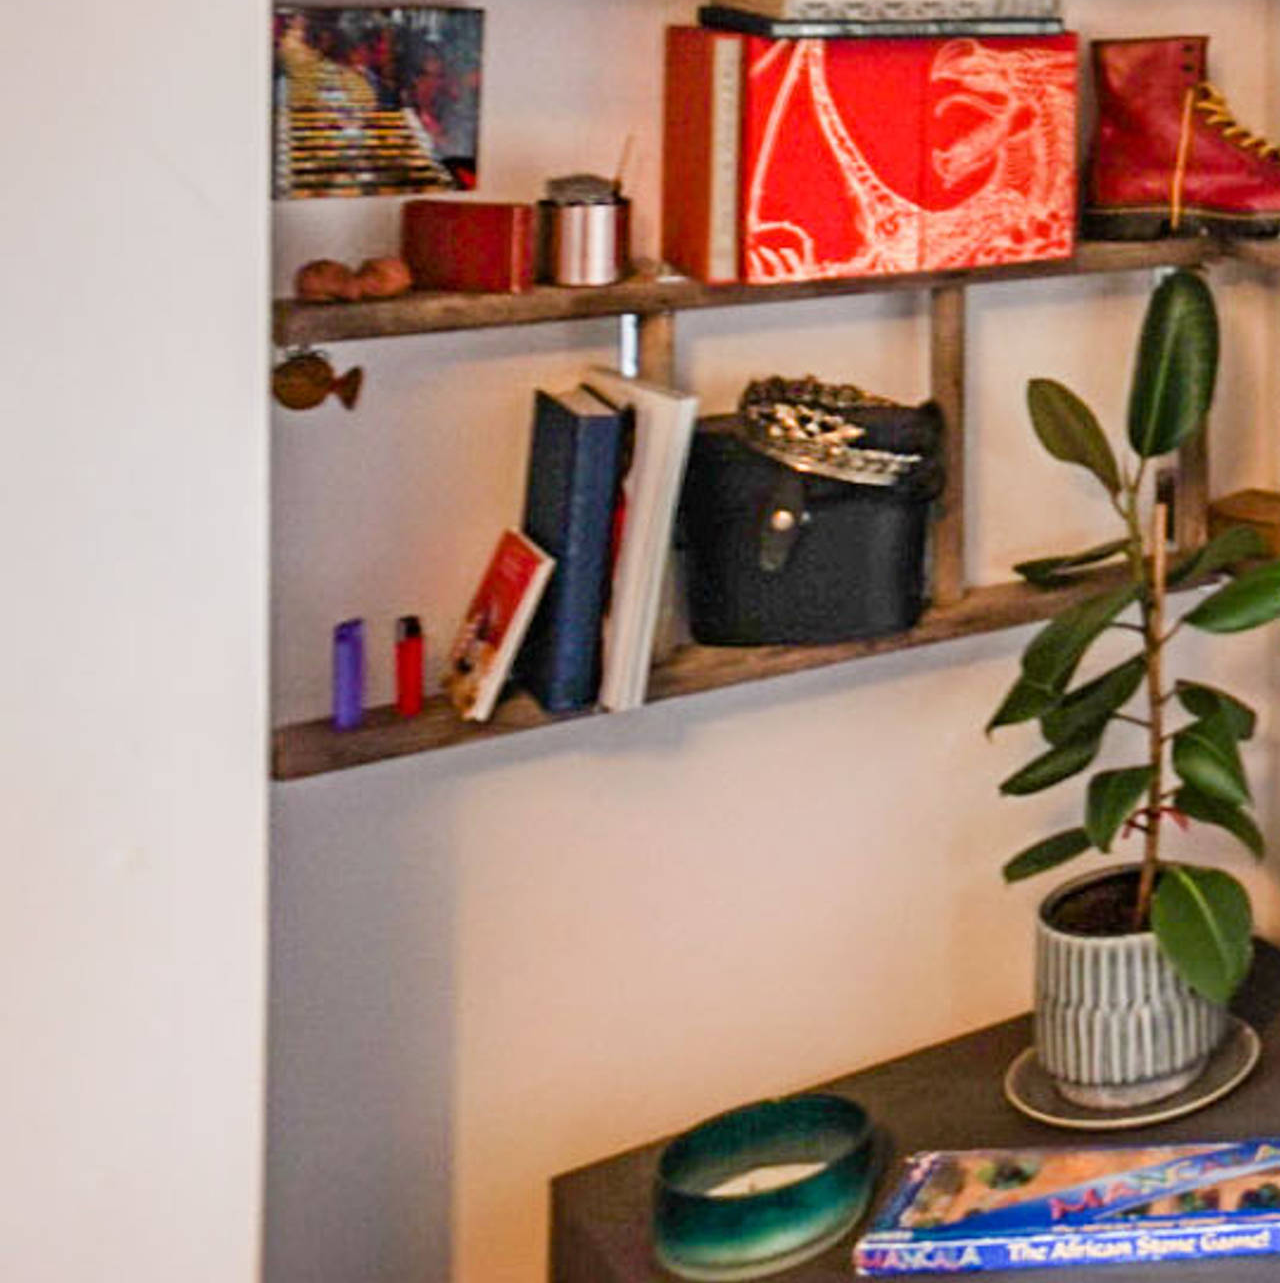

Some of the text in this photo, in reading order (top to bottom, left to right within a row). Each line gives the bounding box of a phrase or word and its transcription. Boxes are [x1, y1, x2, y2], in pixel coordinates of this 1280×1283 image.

[1006, 1228, 1272, 1262] The African Stone Game!
